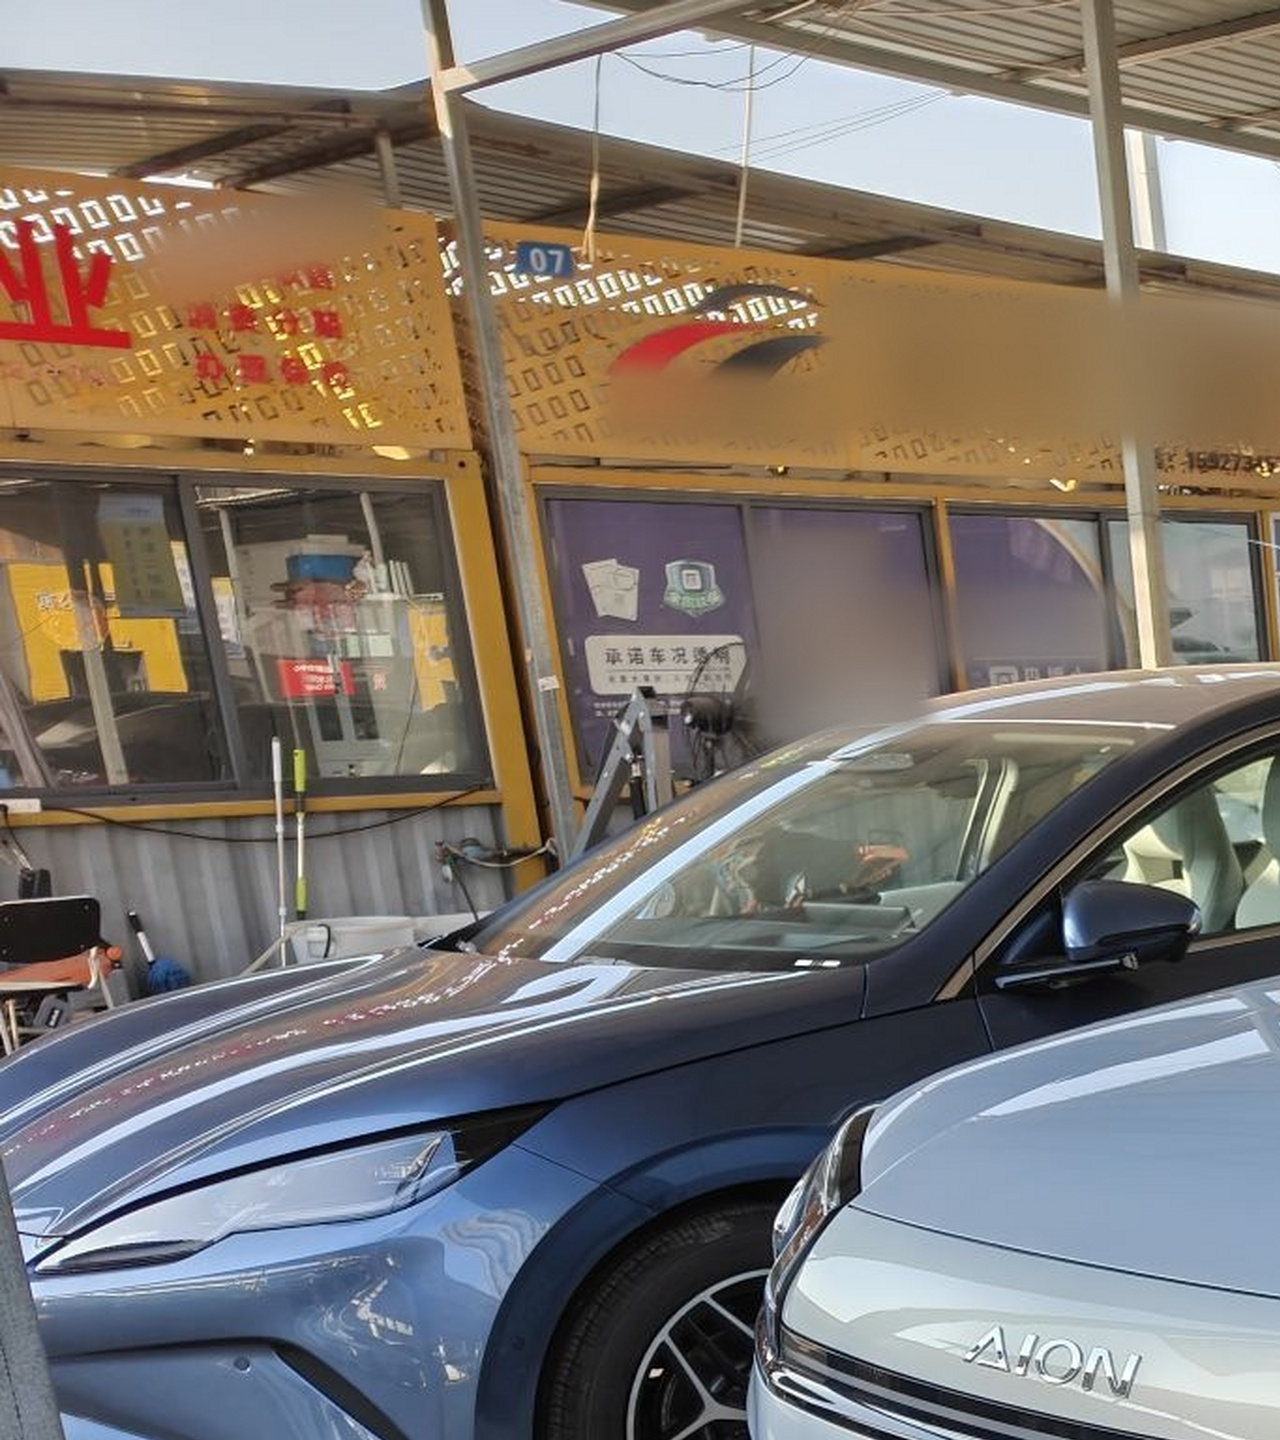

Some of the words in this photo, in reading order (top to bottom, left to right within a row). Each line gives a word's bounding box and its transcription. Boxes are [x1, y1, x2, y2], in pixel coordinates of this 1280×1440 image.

[0, 221, 132, 349] 业
[529, 247, 566, 274] 07
[963, 1322, 1143, 1399] AION
